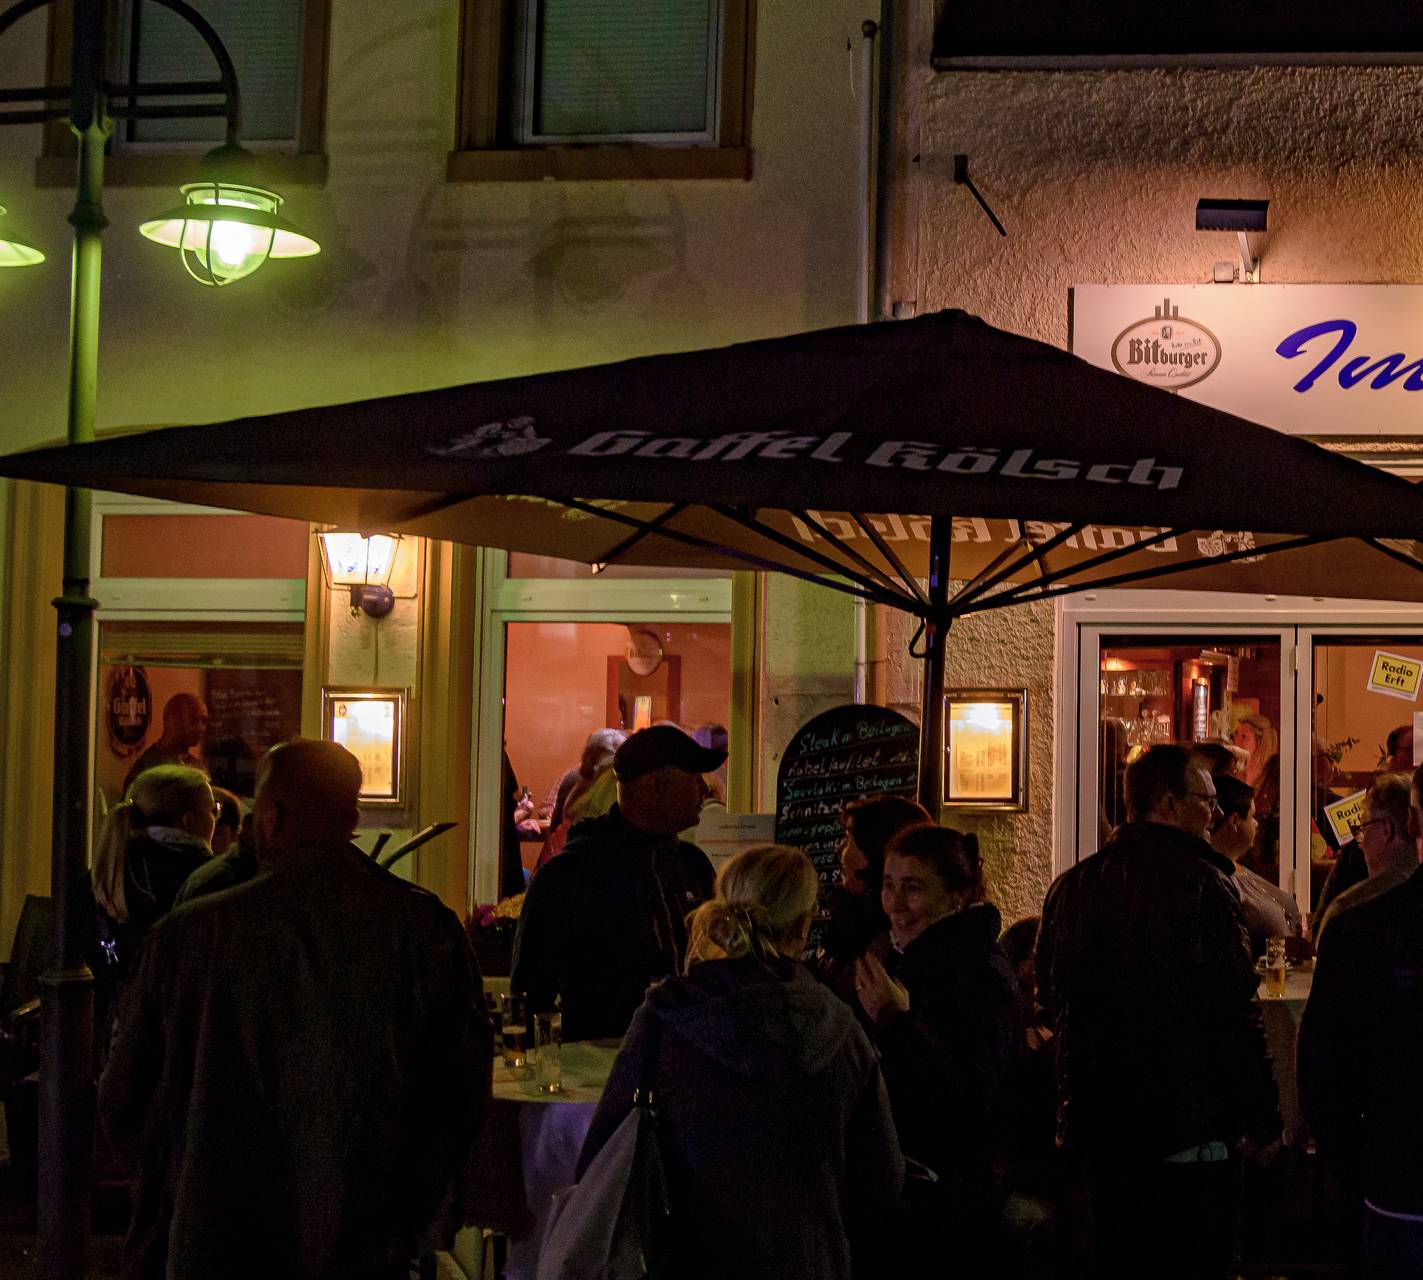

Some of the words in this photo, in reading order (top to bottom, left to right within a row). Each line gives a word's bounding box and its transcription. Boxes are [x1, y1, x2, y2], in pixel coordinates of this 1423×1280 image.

[1127, 337, 1208, 369] Bitburger
[566, 430, 853, 462] Gaffel
[865, 440, 1184, 490] Kölsch
[1381, 661, 1414, 678] Radio
[1384, 674, 1406, 687] Erft
[1336, 802, 1362, 821] Radi
[1346, 814, 1362, 827] Erf
